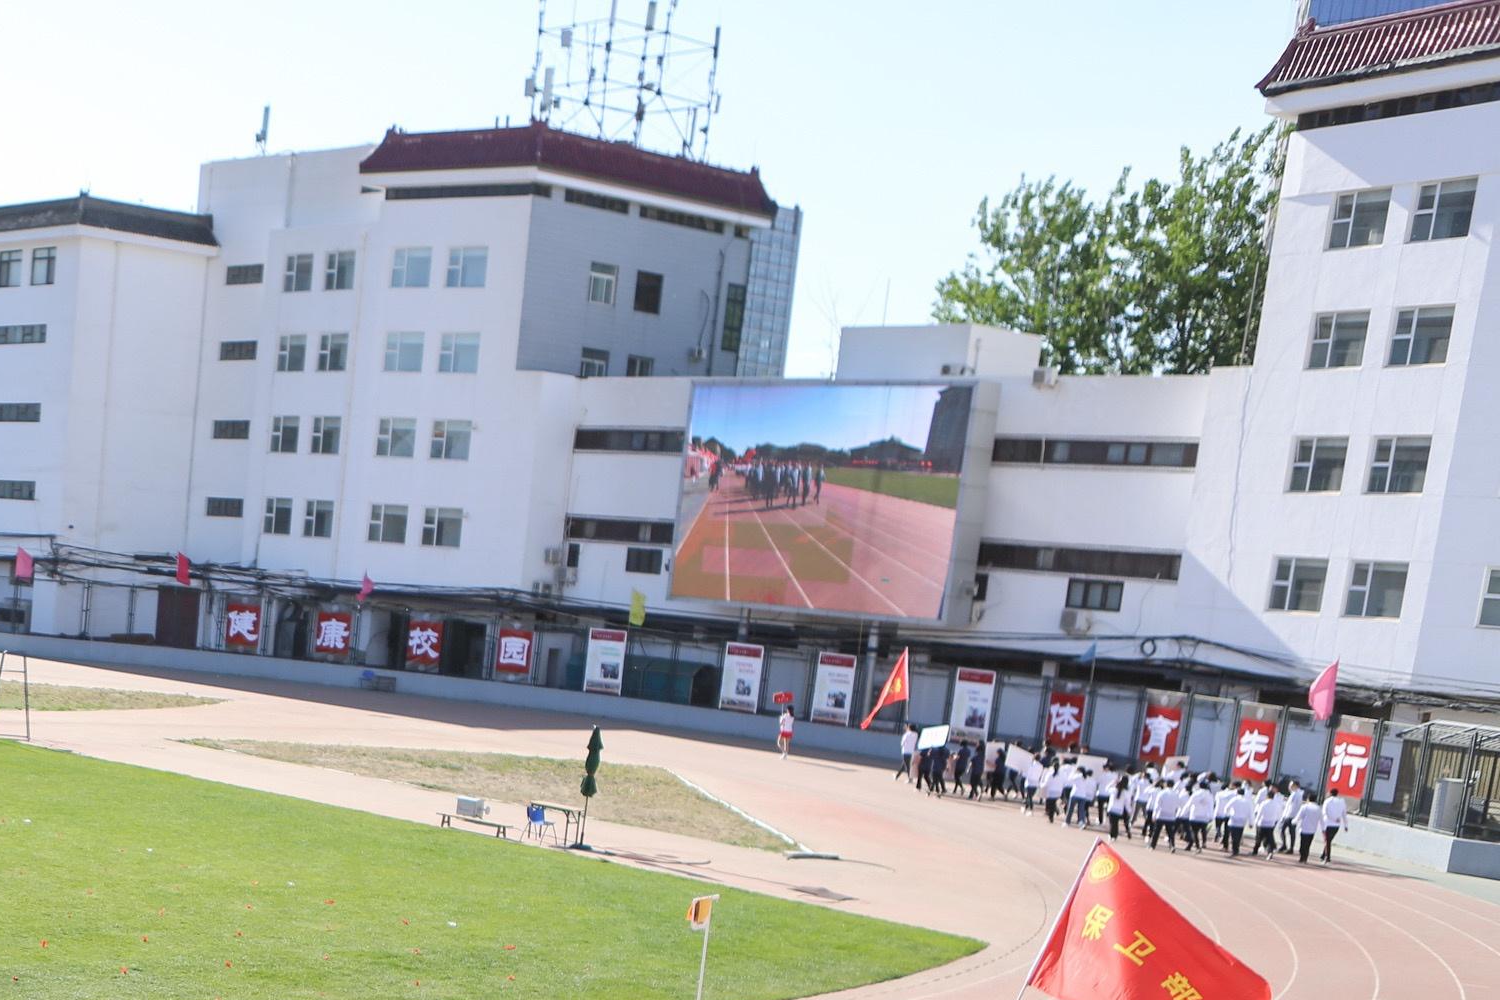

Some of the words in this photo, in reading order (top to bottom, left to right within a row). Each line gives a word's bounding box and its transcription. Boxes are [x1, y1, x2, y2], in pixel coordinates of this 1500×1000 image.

[227, 610, 258, 641] 健
[316, 618, 349, 649] 康
[408, 627, 439, 658] 校
[499, 636, 530, 667] 园
[1050, 702, 1081, 740] 体
[1142, 714, 1179, 757] 育
[1236, 728, 1270, 774] 先
[1330, 741, 1368, 788] 行
